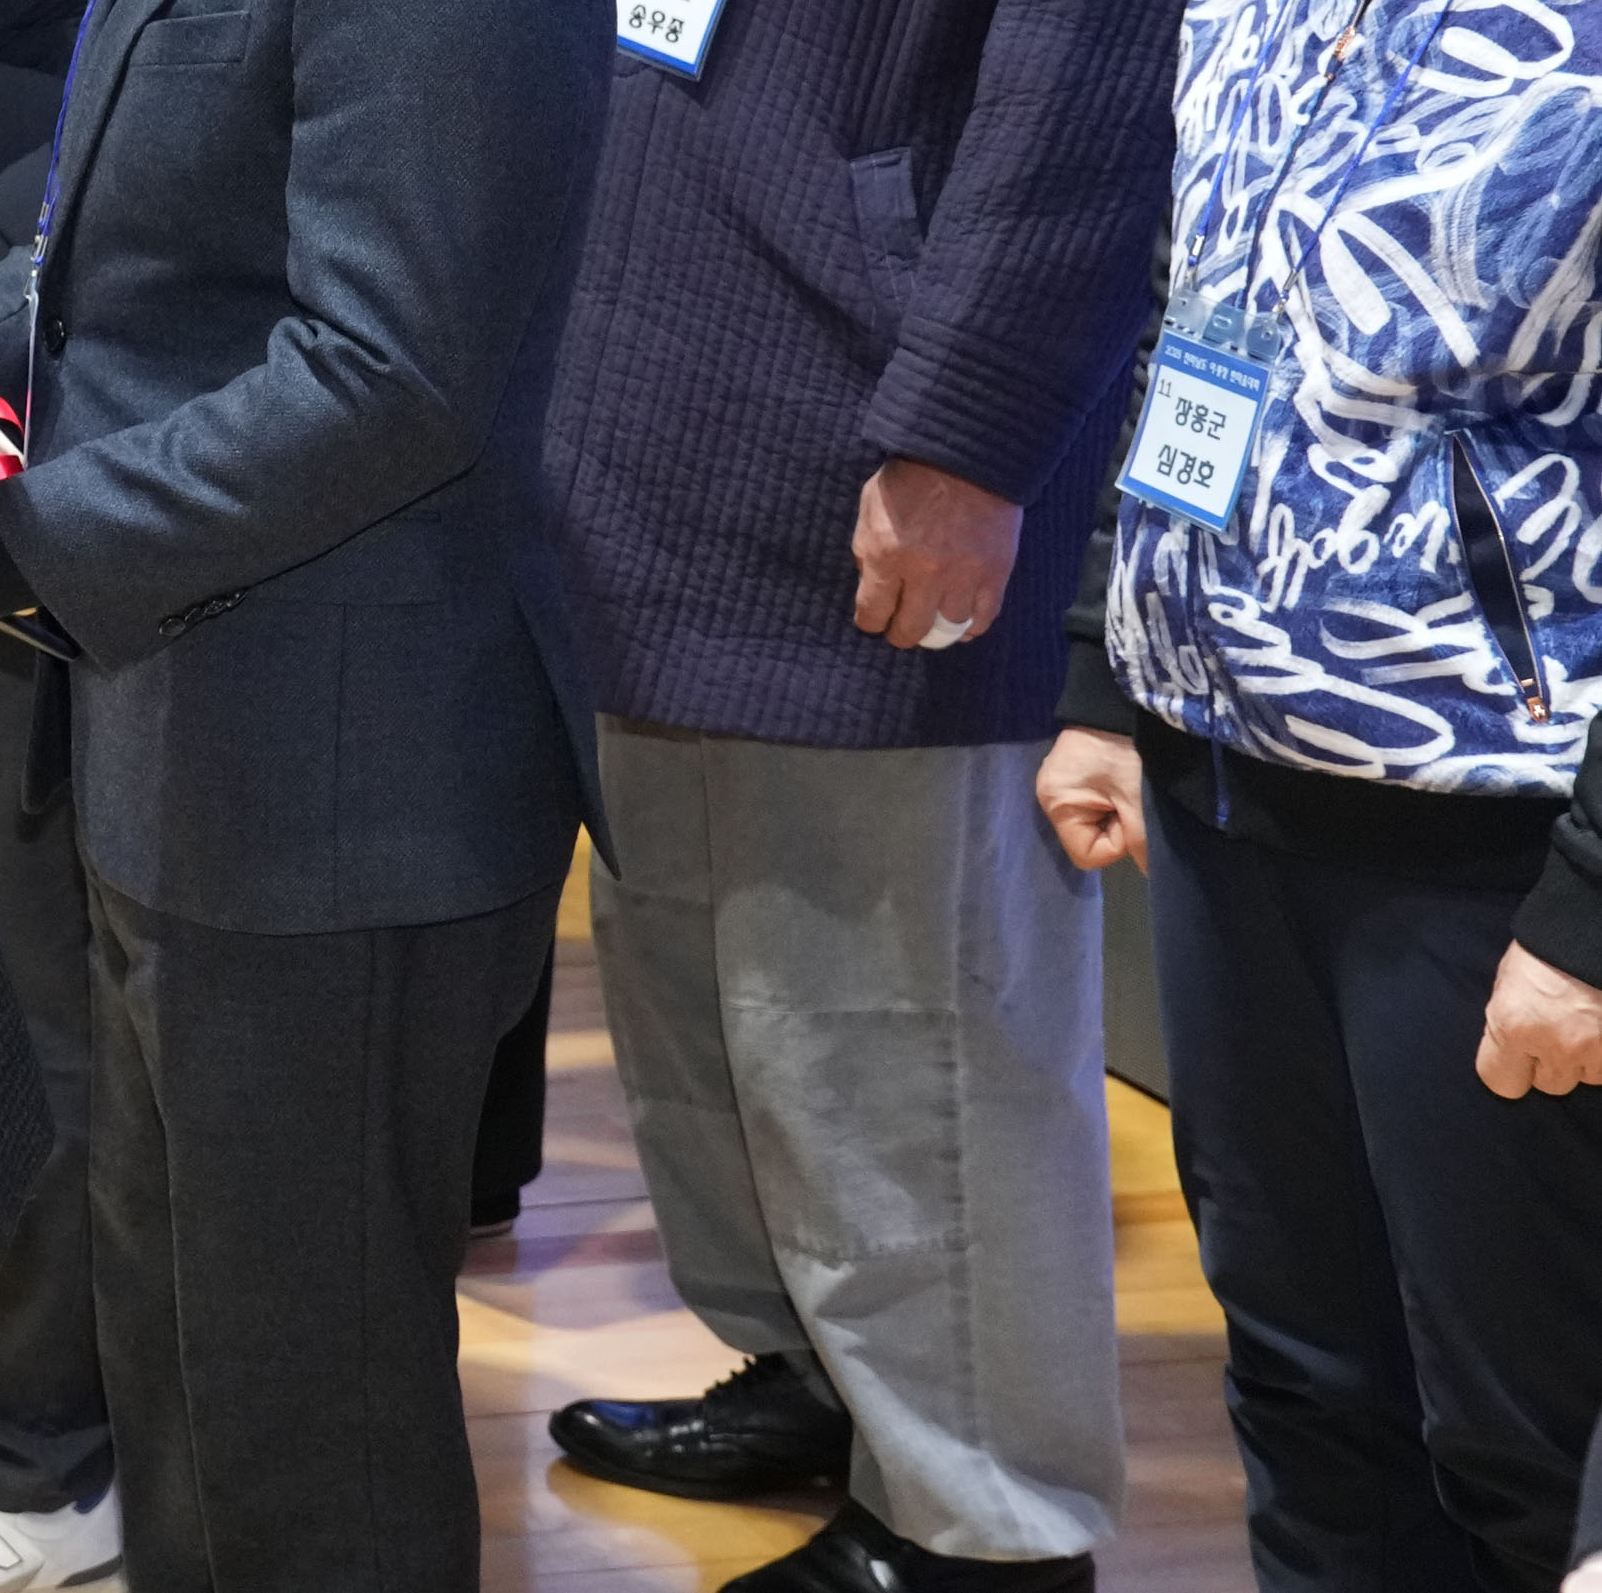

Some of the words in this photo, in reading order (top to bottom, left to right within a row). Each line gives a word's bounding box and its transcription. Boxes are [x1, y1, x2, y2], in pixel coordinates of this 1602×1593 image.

[1157, 378, 1172, 398] 11
[1175, 397, 1226, 440] 장흥군
[1157, 444, 1215, 488] 심경호
